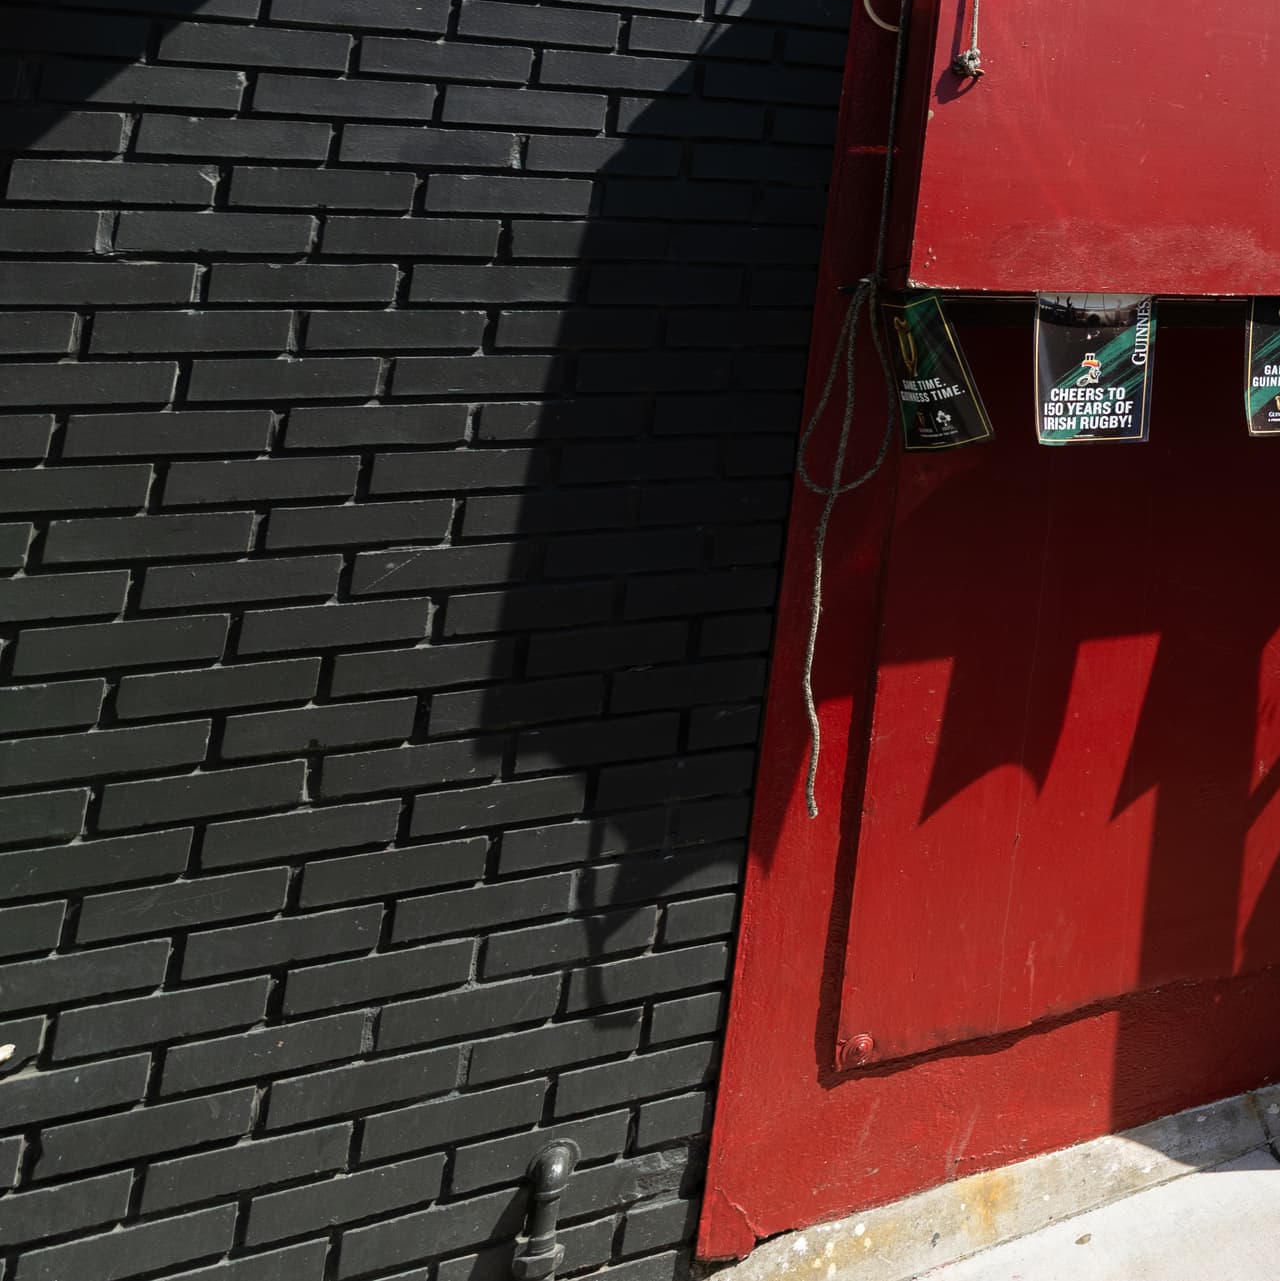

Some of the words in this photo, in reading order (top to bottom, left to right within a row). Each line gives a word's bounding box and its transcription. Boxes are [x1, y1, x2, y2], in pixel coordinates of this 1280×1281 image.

[930, 384, 966, 401] TIME.
[1050, 387, 1104, 401] CHEERS
[1107, 387, 1126, 400] TO
[1044, 402, 1063, 416] 150
[1067, 401, 1111, 415] YEARS
[1115, 400, 1133, 414] OF
[1044, 416, 1076, 430] IRISH
[1079, 414, 1133, 429] RUGBY!
